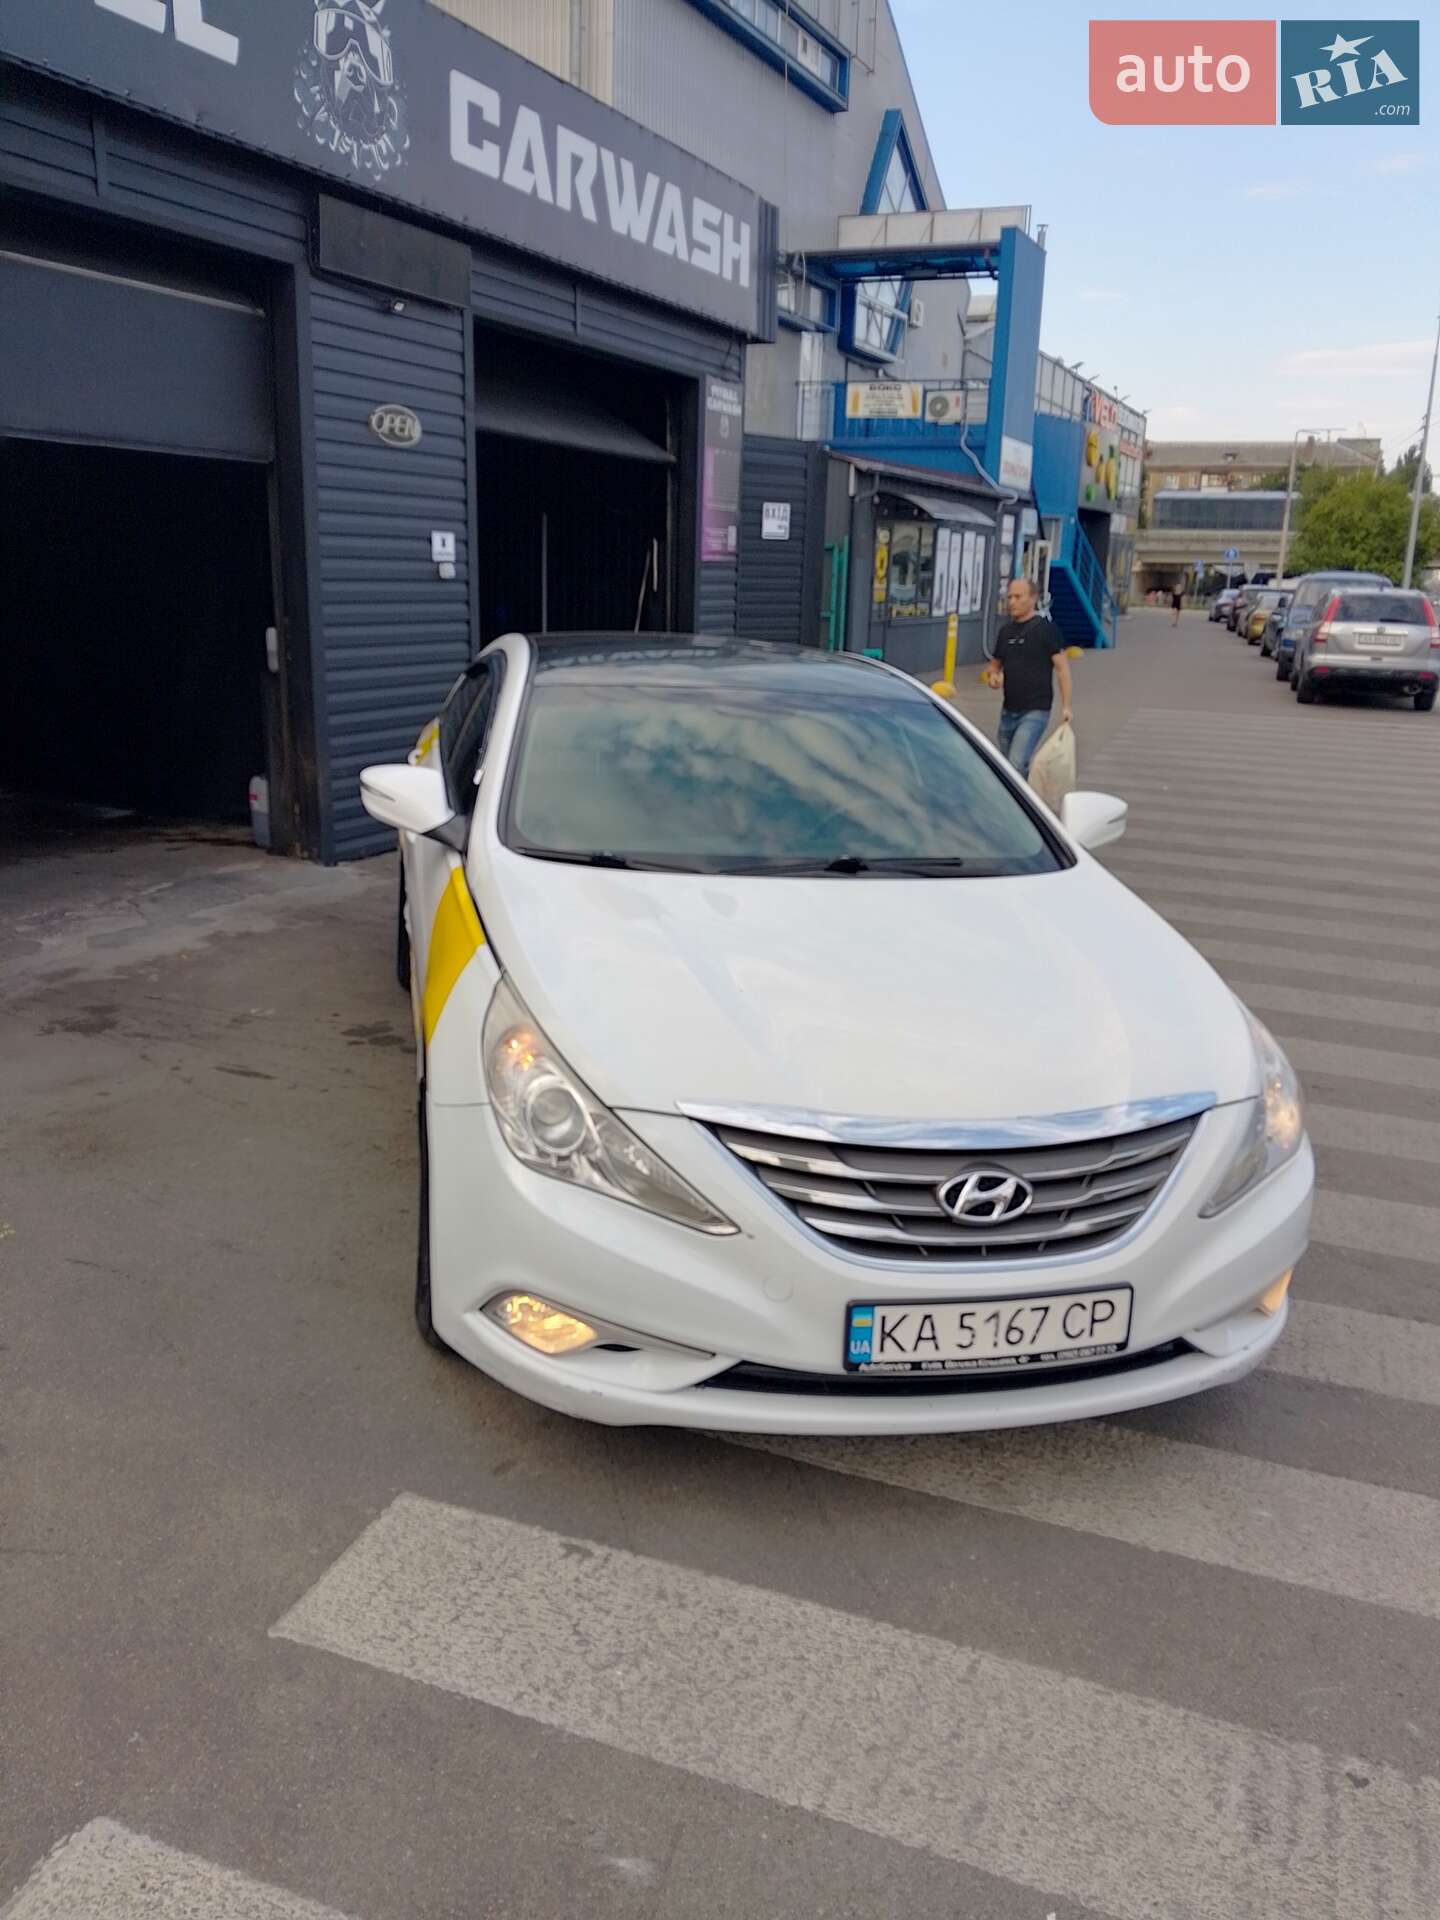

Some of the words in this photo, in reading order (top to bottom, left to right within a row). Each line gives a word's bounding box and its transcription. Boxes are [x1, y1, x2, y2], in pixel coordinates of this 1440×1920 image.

[449, 68, 752, 289] CARWASH
[371, 411, 418, 438] OPEN
[850, 1340, 871, 1354] UA
[879, 1313, 940, 1354] KA
[955, 1306, 1050, 1350] 5167
[1062, 1299, 1116, 1340] CP
